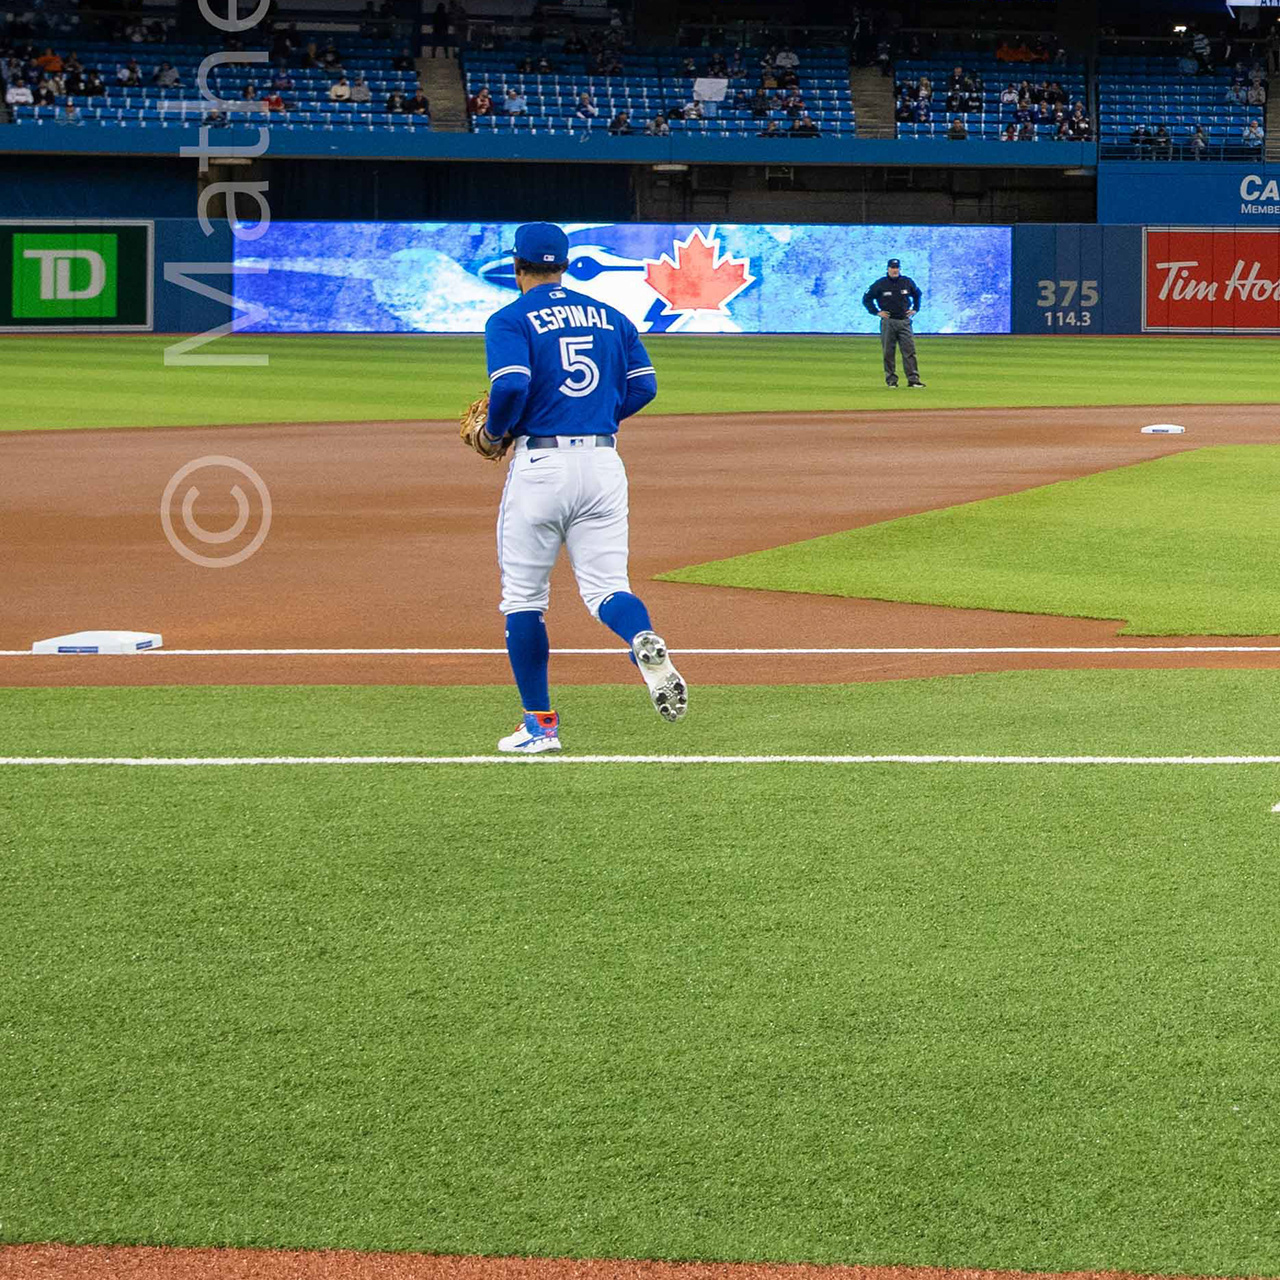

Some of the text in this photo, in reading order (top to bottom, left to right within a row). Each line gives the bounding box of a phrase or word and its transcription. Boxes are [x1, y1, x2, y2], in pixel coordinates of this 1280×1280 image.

[23, 250, 106, 299] TD
[1155, 261, 1217, 302] Tim
[1037, 280, 1098, 306] 375
[527, 304, 616, 334] ESPINAL
[1045, 312, 1090, 326] 114.3
[559, 335, 599, 397] 5
